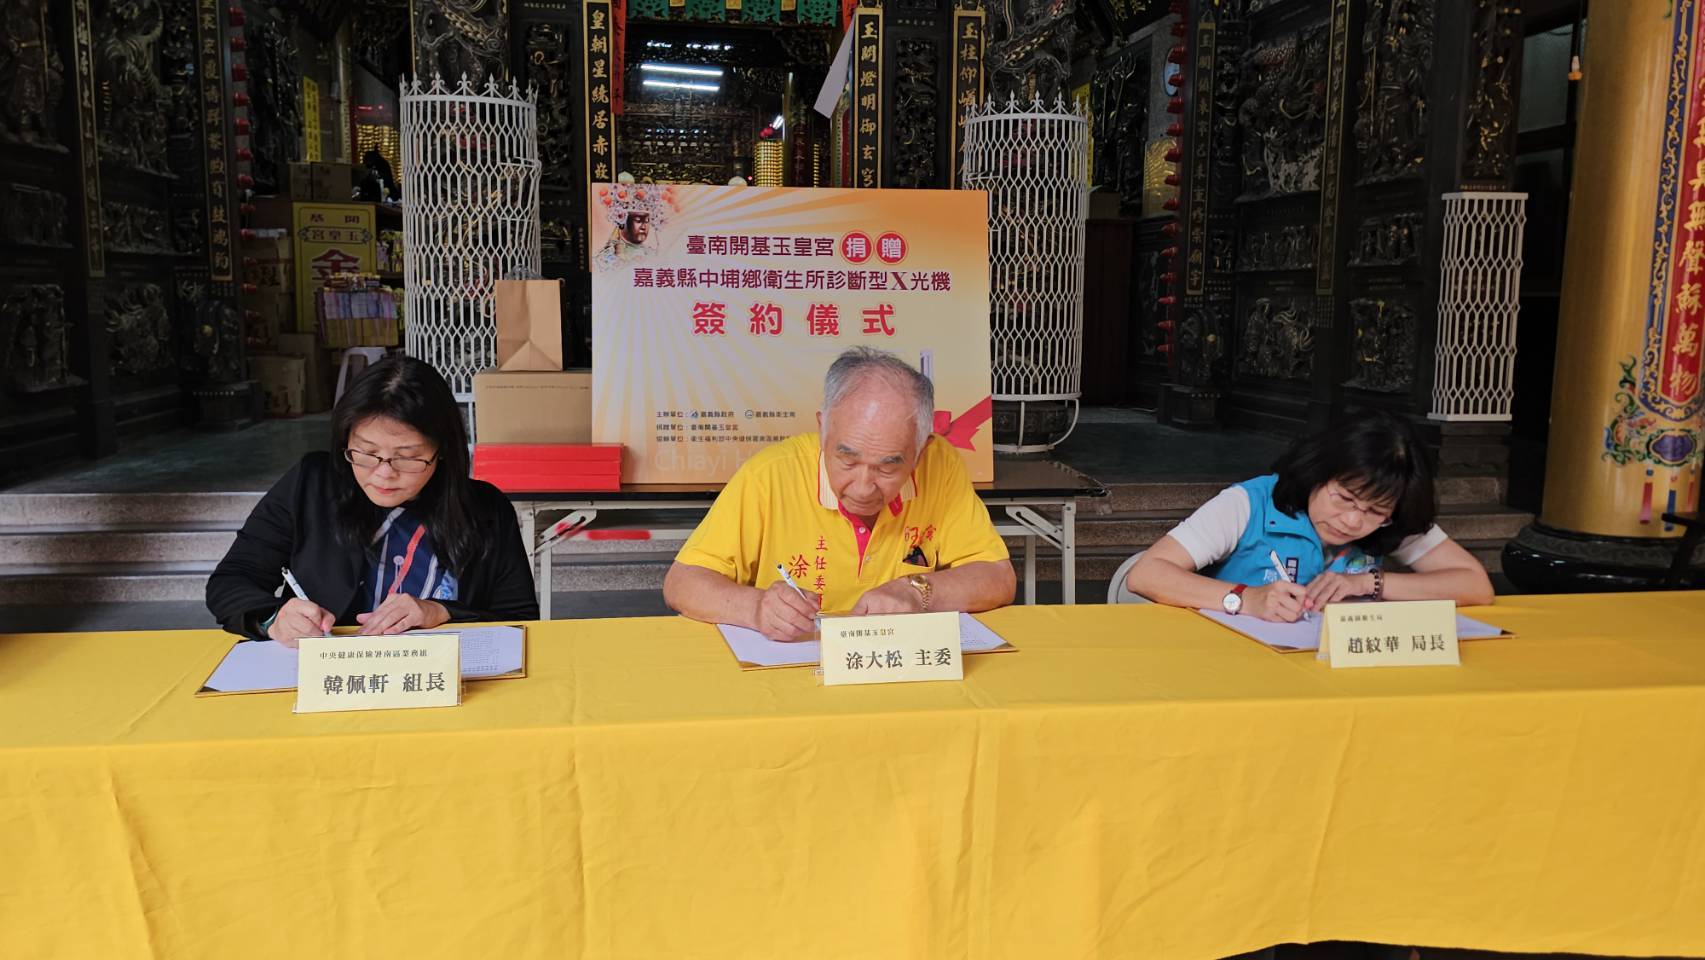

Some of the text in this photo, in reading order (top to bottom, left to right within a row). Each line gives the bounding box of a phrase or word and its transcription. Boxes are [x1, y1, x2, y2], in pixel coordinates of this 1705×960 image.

[686, 235, 834, 257] 臺南開基玉皇宮
[633, 267, 951, 291] 嘉義縣中埔鄉衛生所診斷型X光機
[814, 535, 828, 609] 主任委
[1348, 633, 1445, 653] 趙紋華 局長
[846, 647, 952, 670] 涂大松 主委
[323, 671, 446, 695] 韓佩軒 組長
